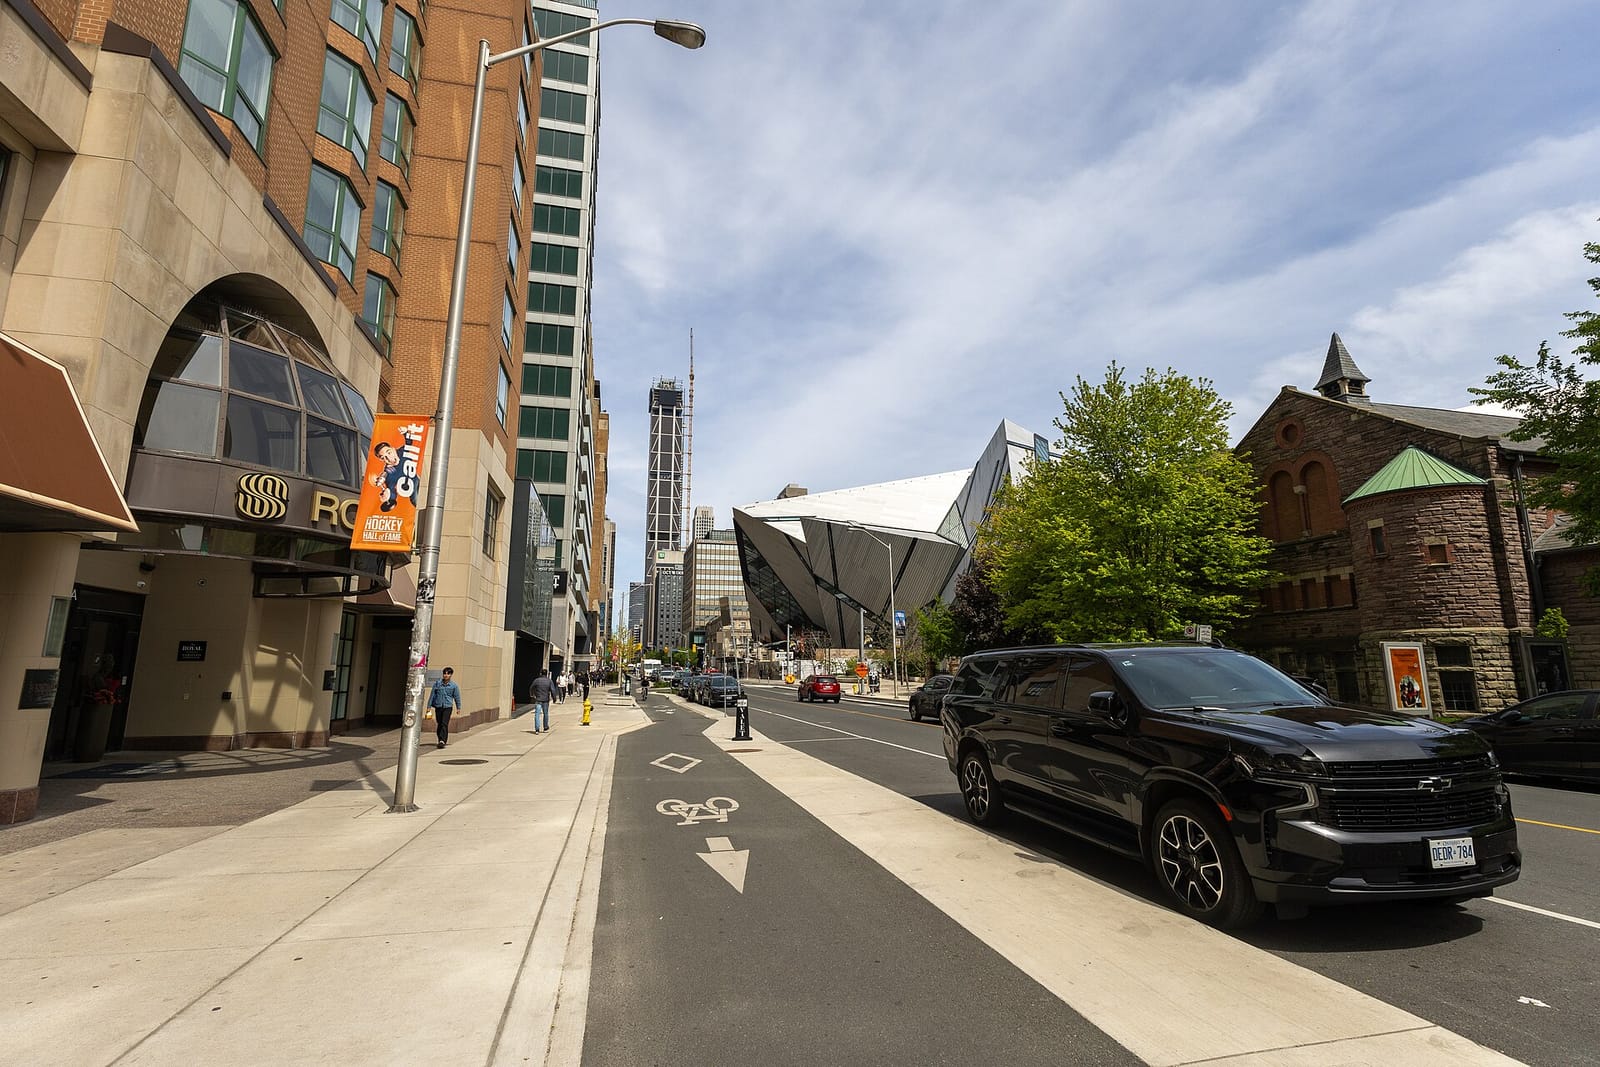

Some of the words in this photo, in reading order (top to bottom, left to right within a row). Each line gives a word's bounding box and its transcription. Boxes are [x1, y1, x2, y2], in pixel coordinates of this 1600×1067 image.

[406, 423, 425, 442] it
[364, 518, 403, 531] HOCKEY
[363, 531, 377, 540] HALL
[385, 532, 402, 542] FAME
